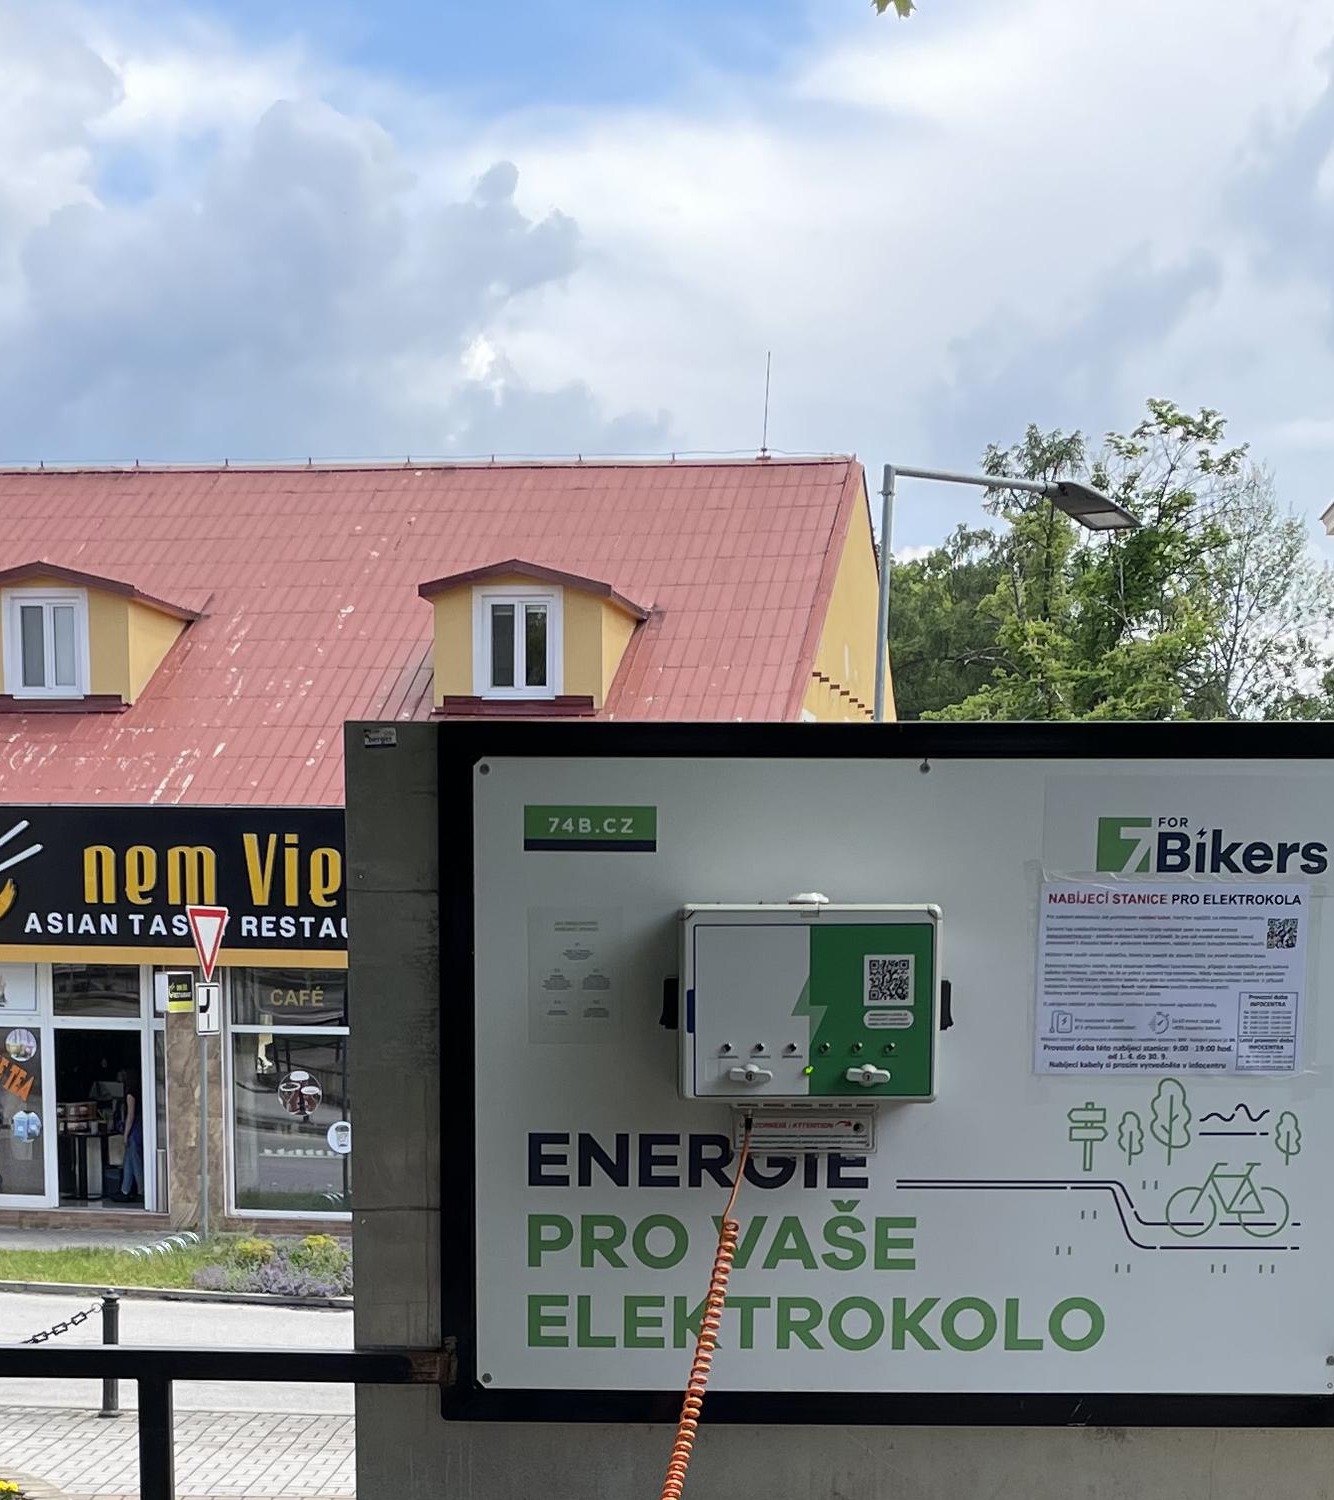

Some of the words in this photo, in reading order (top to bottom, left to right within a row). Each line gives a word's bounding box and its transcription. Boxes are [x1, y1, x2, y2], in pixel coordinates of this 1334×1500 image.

[548, 817, 634, 833] 74B.CZ
[1158, 817, 1189, 828] FOR
[1156, 828, 1328, 875] Bikers
[83, 845, 217, 905] nem
[1048, 890, 1109, 905] NABÍJECÍ
[1112, 893, 1167, 905] STANICE
[1171, 893, 1200, 905] PRO
[1203, 894, 1302, 905] ELEKTROKOLA
[24, 913, 117, 934] ASIAN
[129, 914, 230, 936] TAS
[270, 986, 325, 1006] CAFÉ
[3, 1064, 35, 1101] TEA
[527, 1132, 869, 1189] ENERGIE
[527, 1213, 690, 1269] PRO
[711, 1199, 917, 1271] VAŠE
[527, 1295, 1107, 1352] ELEKTROKOLO
